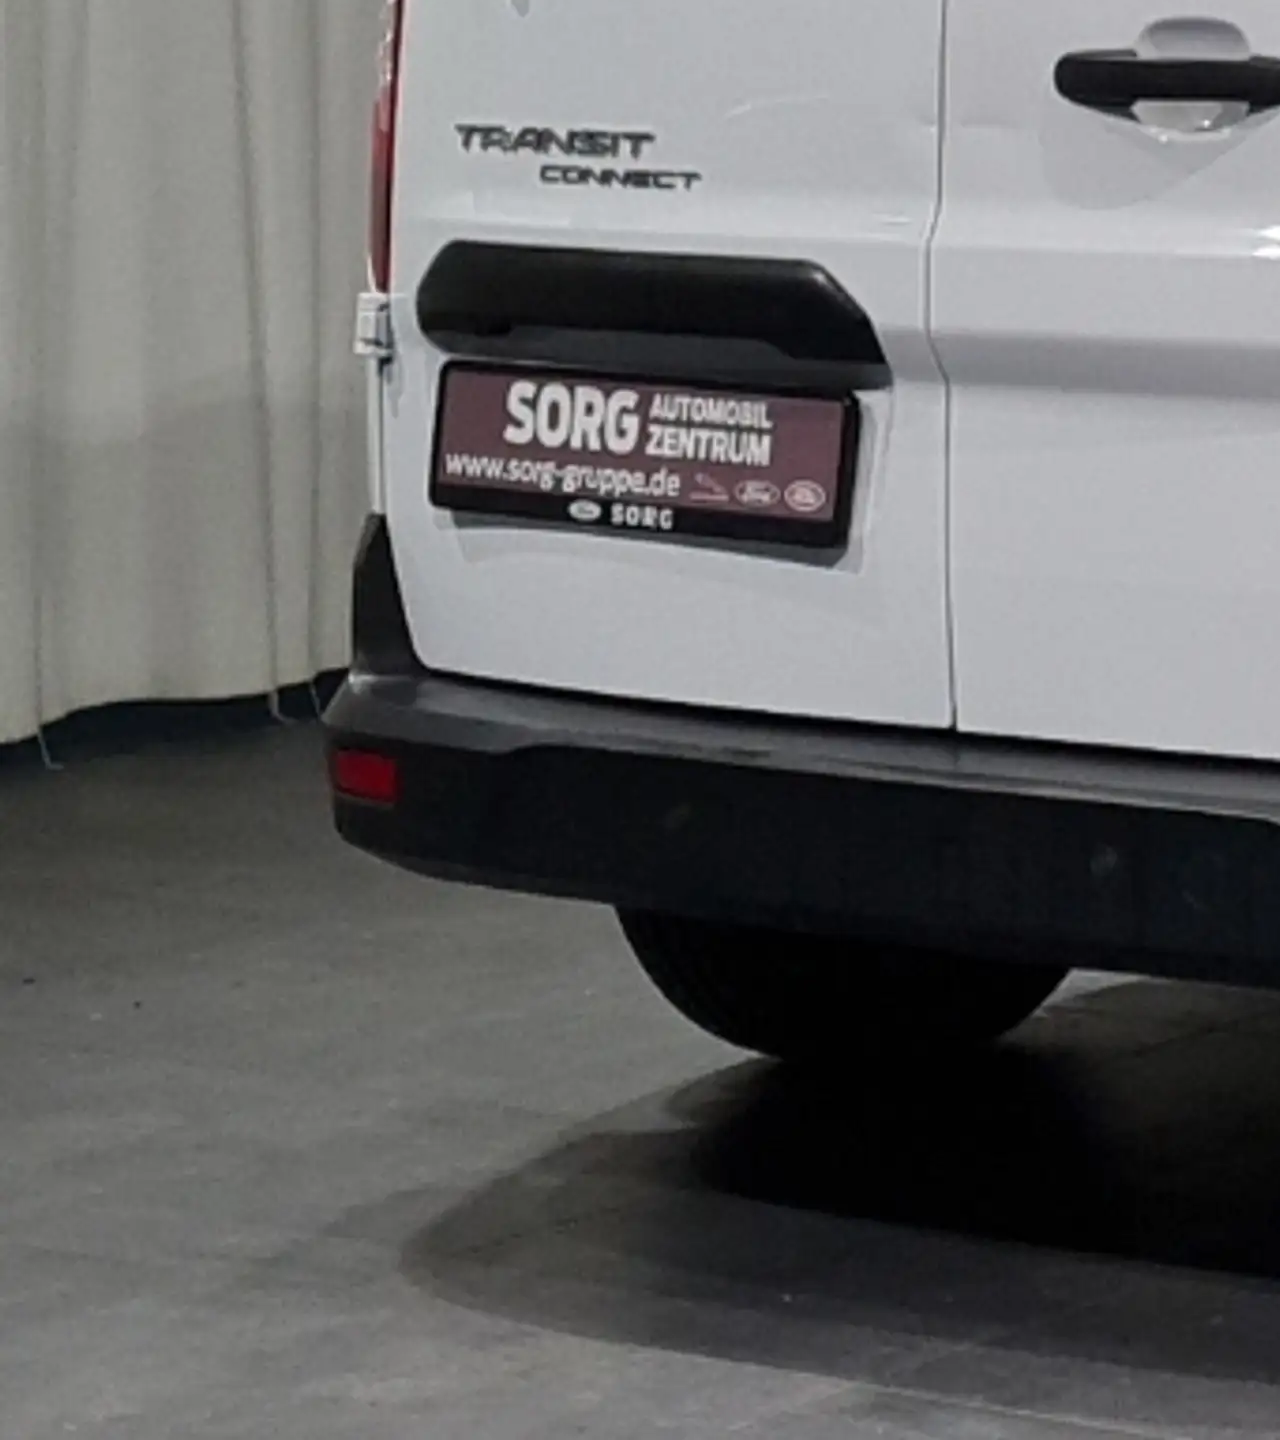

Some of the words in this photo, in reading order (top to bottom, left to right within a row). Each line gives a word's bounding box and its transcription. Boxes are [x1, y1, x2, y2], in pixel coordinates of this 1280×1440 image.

[454, 123, 656, 160] TRANSIT
[539, 164, 702, 190] CONNECT
[503, 380, 640, 455] SORG
[649, 392, 773, 429] AUTOMOBIL
[645, 423, 772, 467] ZENTRUM
[445, 453, 681, 498] www.sorg-gruppe.de
[610, 502, 673, 529] SORG
